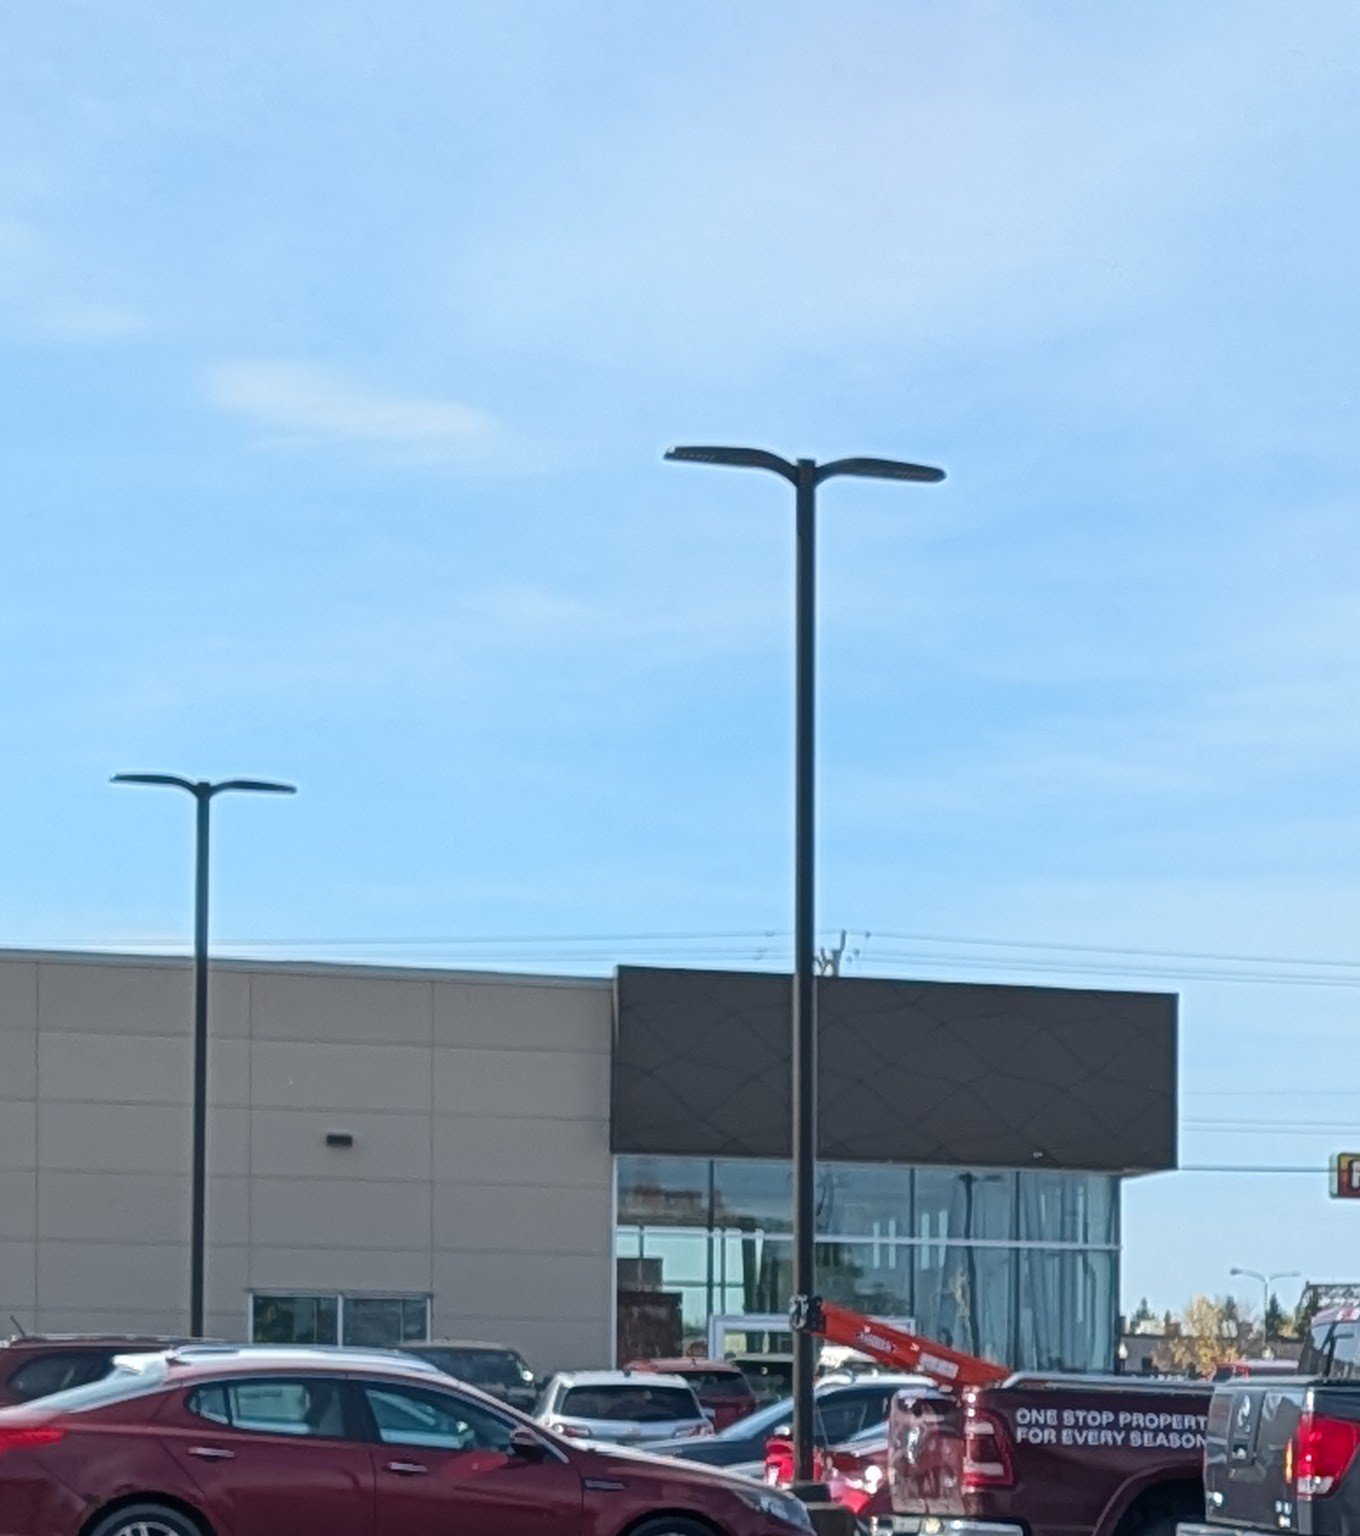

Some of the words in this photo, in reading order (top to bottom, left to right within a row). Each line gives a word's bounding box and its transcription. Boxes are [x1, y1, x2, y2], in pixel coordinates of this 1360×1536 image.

[1016, 1407, 1058, 1425] ONE
[1063, 1409, 1115, 1426] STOP
[1118, 1412, 1208, 1430] PROPERT
[1016, 1427, 1057, 1444] FOR
[1062, 1428, 1125, 1446] EVERY
